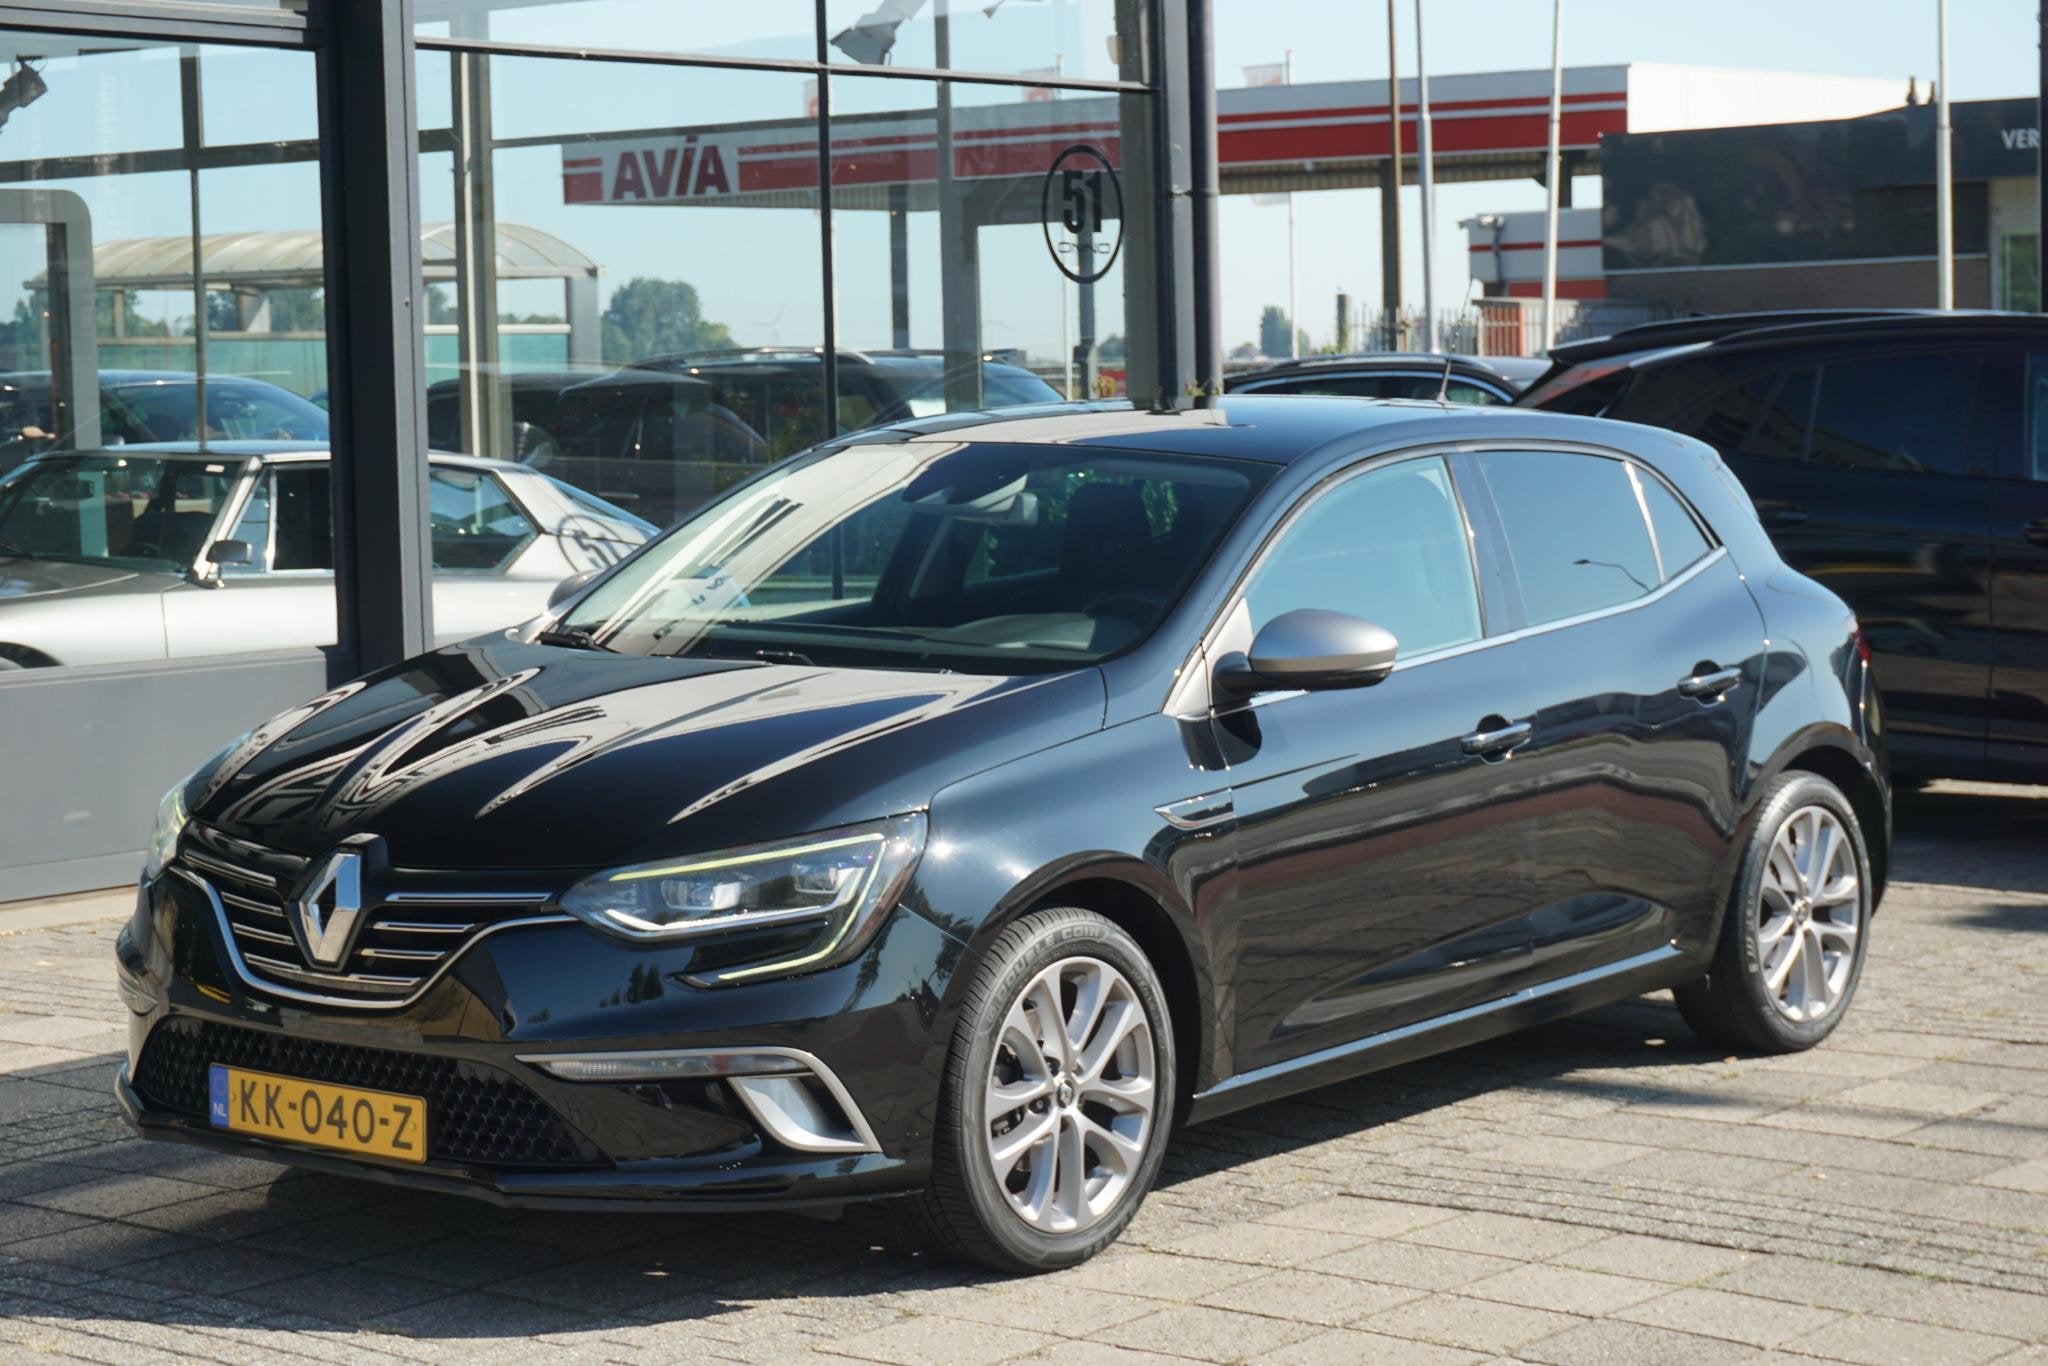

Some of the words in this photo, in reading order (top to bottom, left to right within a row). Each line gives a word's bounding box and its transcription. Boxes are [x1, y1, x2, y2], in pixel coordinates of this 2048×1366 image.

[612, 134, 730, 200] AVIA
[1063, 170, 1102, 234] 51
[1062, 926, 1100, 940] COIN
[213, 1102, 227, 1118] NL
[240, 1079, 412, 1150] KK-040-Z
